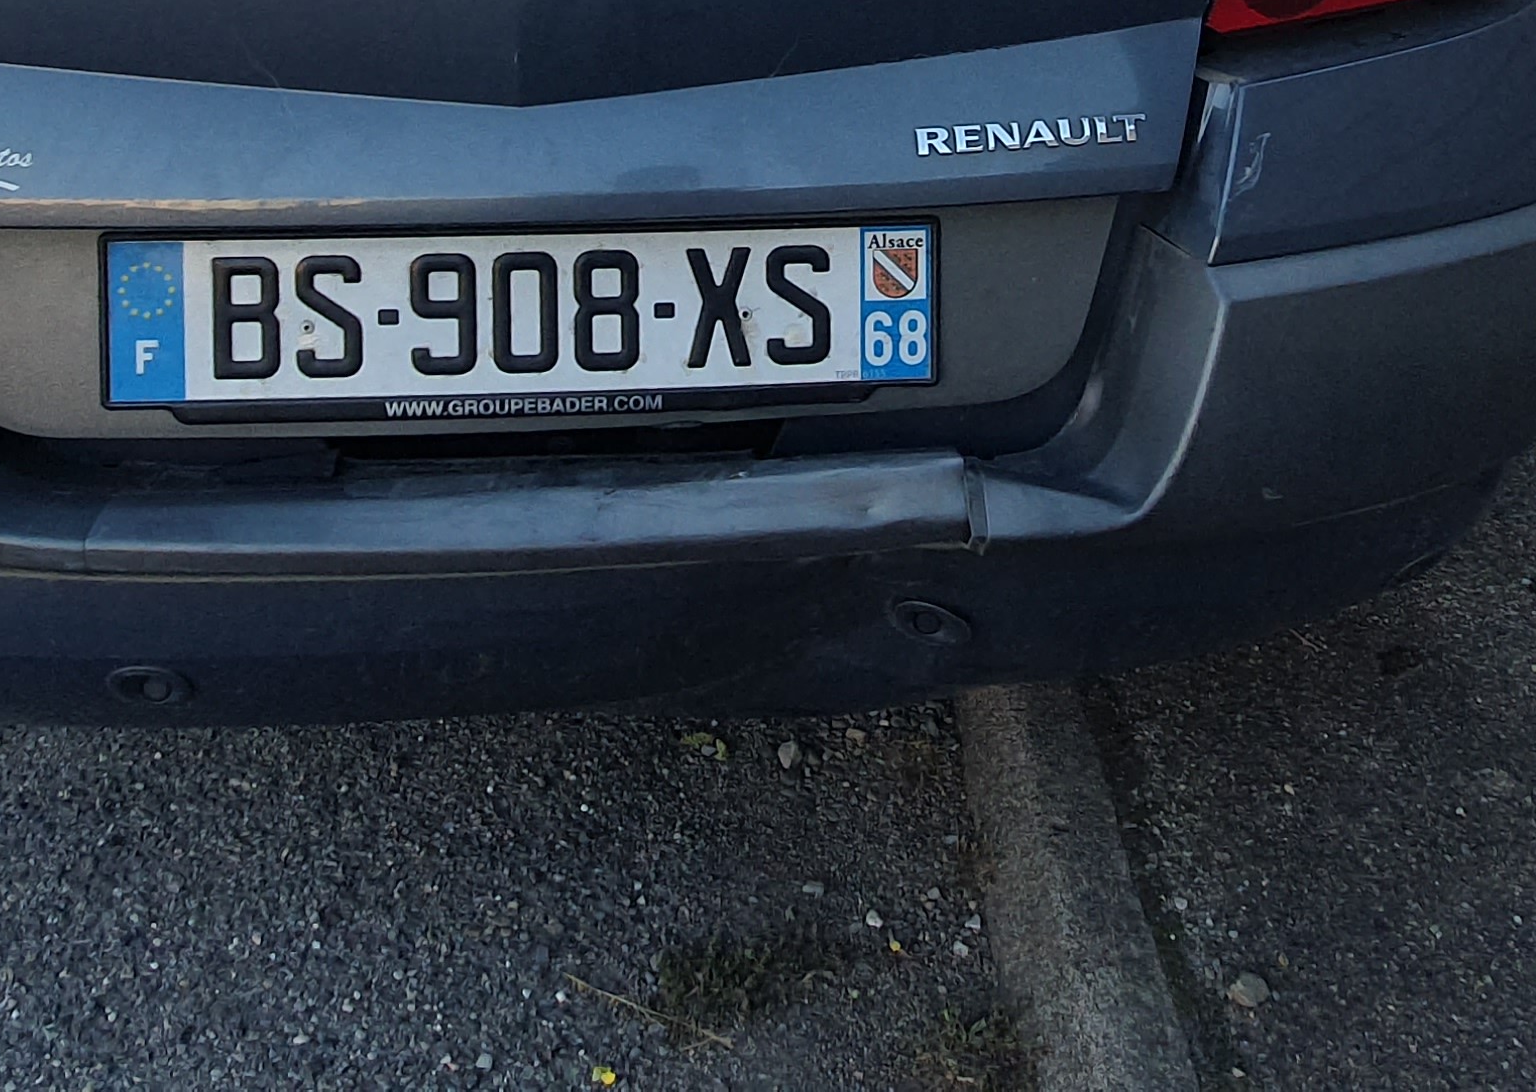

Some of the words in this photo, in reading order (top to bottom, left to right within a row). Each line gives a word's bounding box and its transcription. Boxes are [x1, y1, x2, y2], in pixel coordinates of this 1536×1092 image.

[914, 113, 1146, 156] RENAULT
[867, 233, 924, 249] Alsace
[135, 339, 159, 375] F
[211, 244, 832, 381] BS-908-XS
[864, 309, 927, 367] 68
[385, 394, 664, 417] WWW.GROUPEBADER.COM
